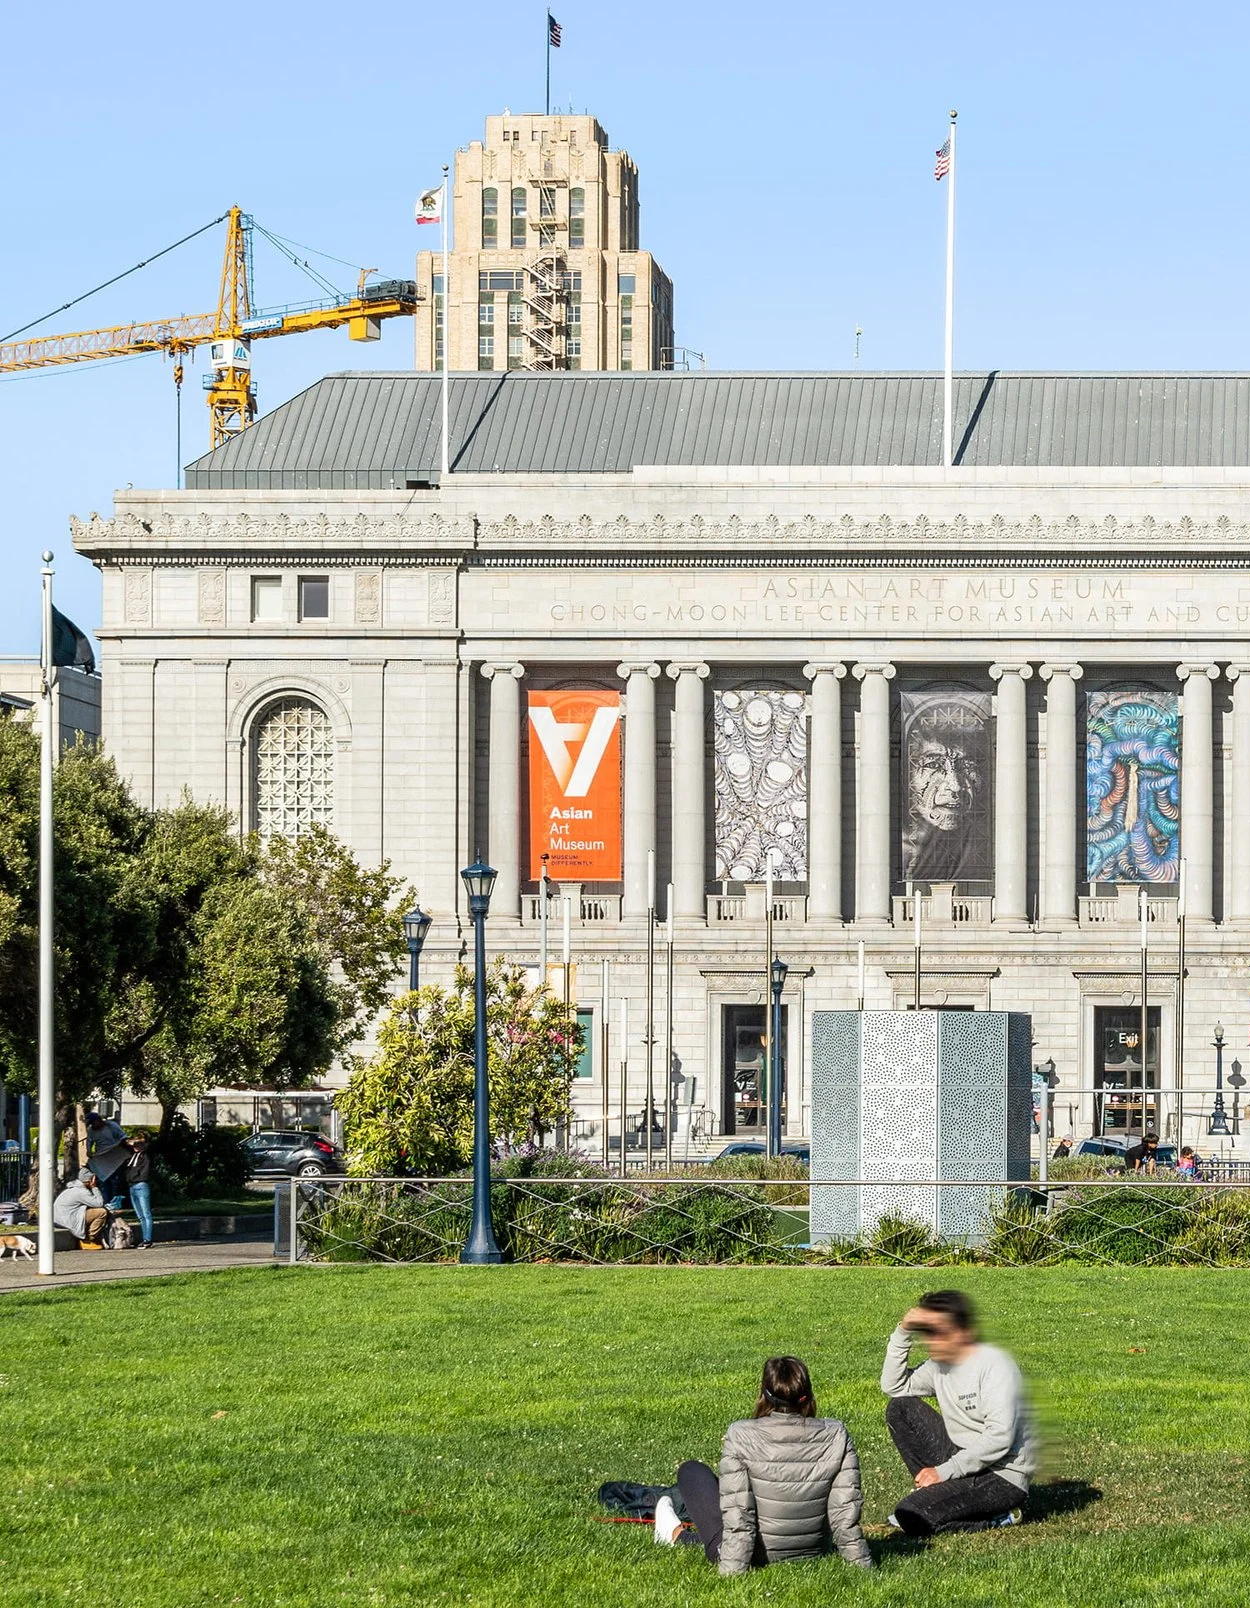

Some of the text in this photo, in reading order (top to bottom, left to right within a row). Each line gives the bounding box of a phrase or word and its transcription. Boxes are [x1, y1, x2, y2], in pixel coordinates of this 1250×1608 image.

[762, 577, 1124, 599] ASIAN ART MUSEUM
[550, 604, 747, 621] CHONG-MOON
[765, 604, 803, 621] LEE
[819, 605, 919, 621] CENTER
[935, 605, 981, 621] FOR
[996, 605, 1074, 622] ASIAN
[1087, 605, 1134, 622] ART
[1148, 606, 1201, 622] AND
[550, 806, 593, 820] Asian
[550, 823, 570, 835] Art
[550, 837, 605, 850] Museum
[1118, 1032, 1139, 1044] Exit
